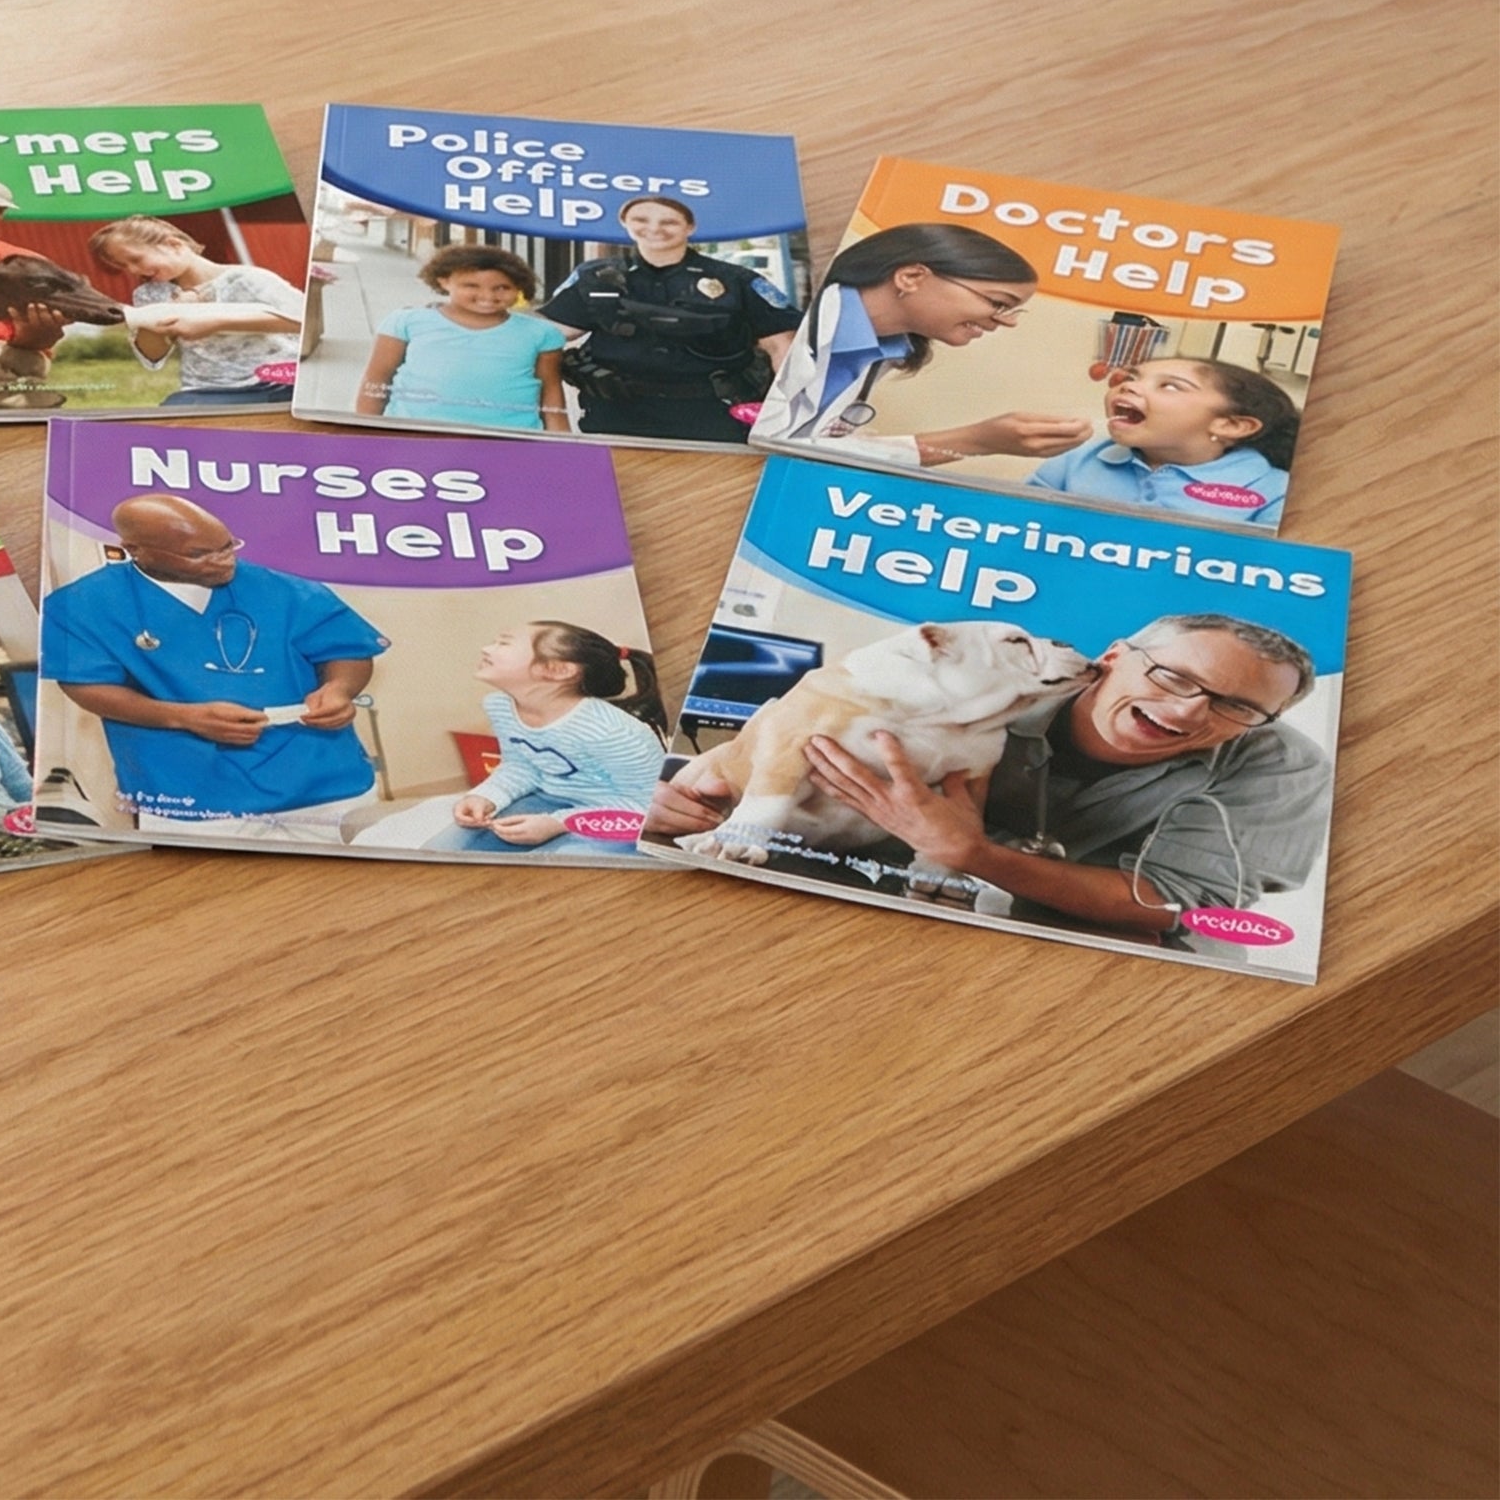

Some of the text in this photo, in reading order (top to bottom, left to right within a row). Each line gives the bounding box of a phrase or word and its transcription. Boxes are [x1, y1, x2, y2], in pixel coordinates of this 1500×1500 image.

[387, 123, 586, 162] Police
[27, 158, 213, 201] Help
[443, 182, 604, 227] Help
[445, 154, 711, 197] Officers
[939, 182, 1276, 266] Doctors
[1053, 244, 1246, 309] Help
[130, 445, 487, 503] Nurses
[315, 510, 545, 572] Help
[807, 527, 1037, 609] Help
[827, 486, 1326, 597] Veterinarians
